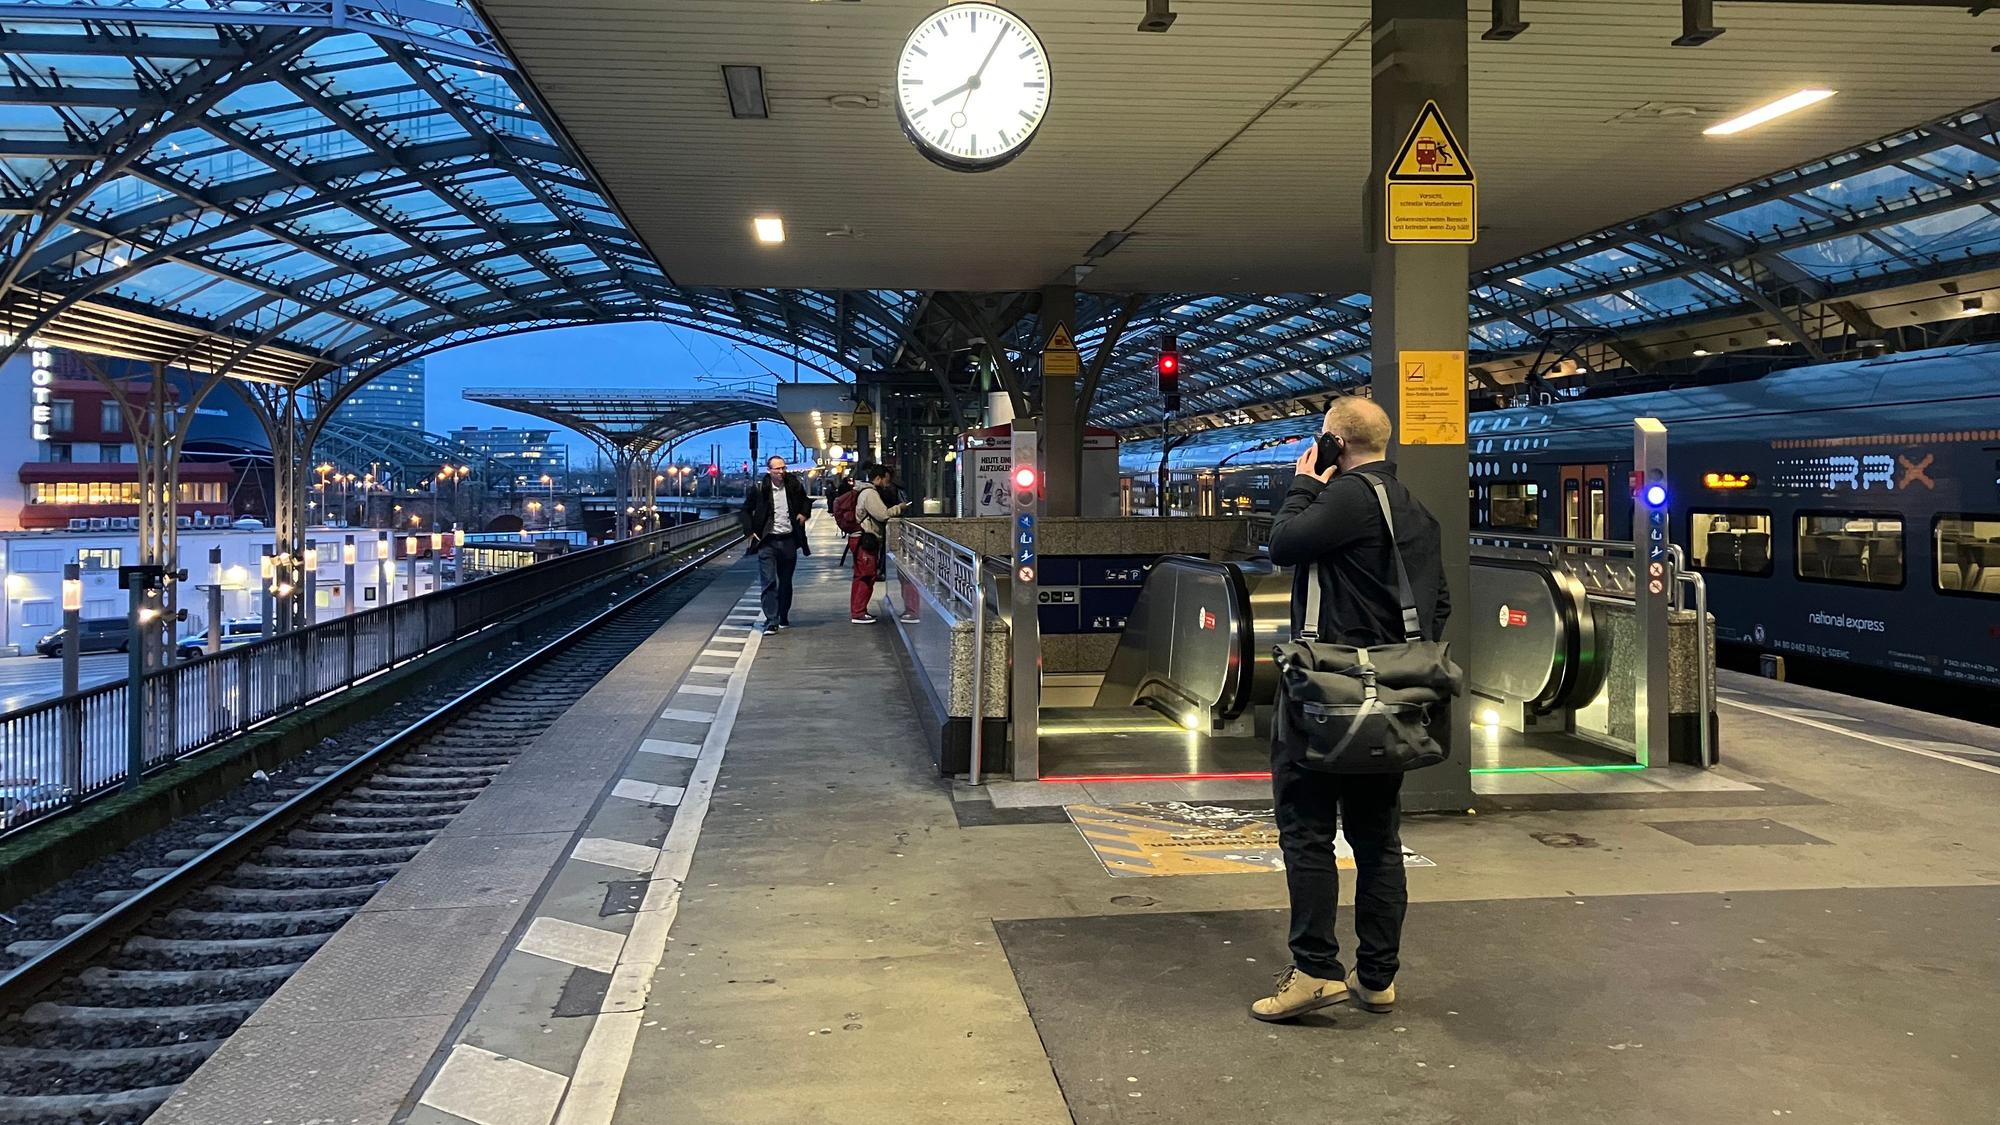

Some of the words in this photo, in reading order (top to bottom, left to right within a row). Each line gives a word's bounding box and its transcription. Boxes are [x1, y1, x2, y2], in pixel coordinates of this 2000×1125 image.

[31, 350, 52, 441] HOTEL
[1829, 453, 1935, 490] RRX
[1809, 610, 1845, 627] national
[1845, 617, 1885, 632] express
